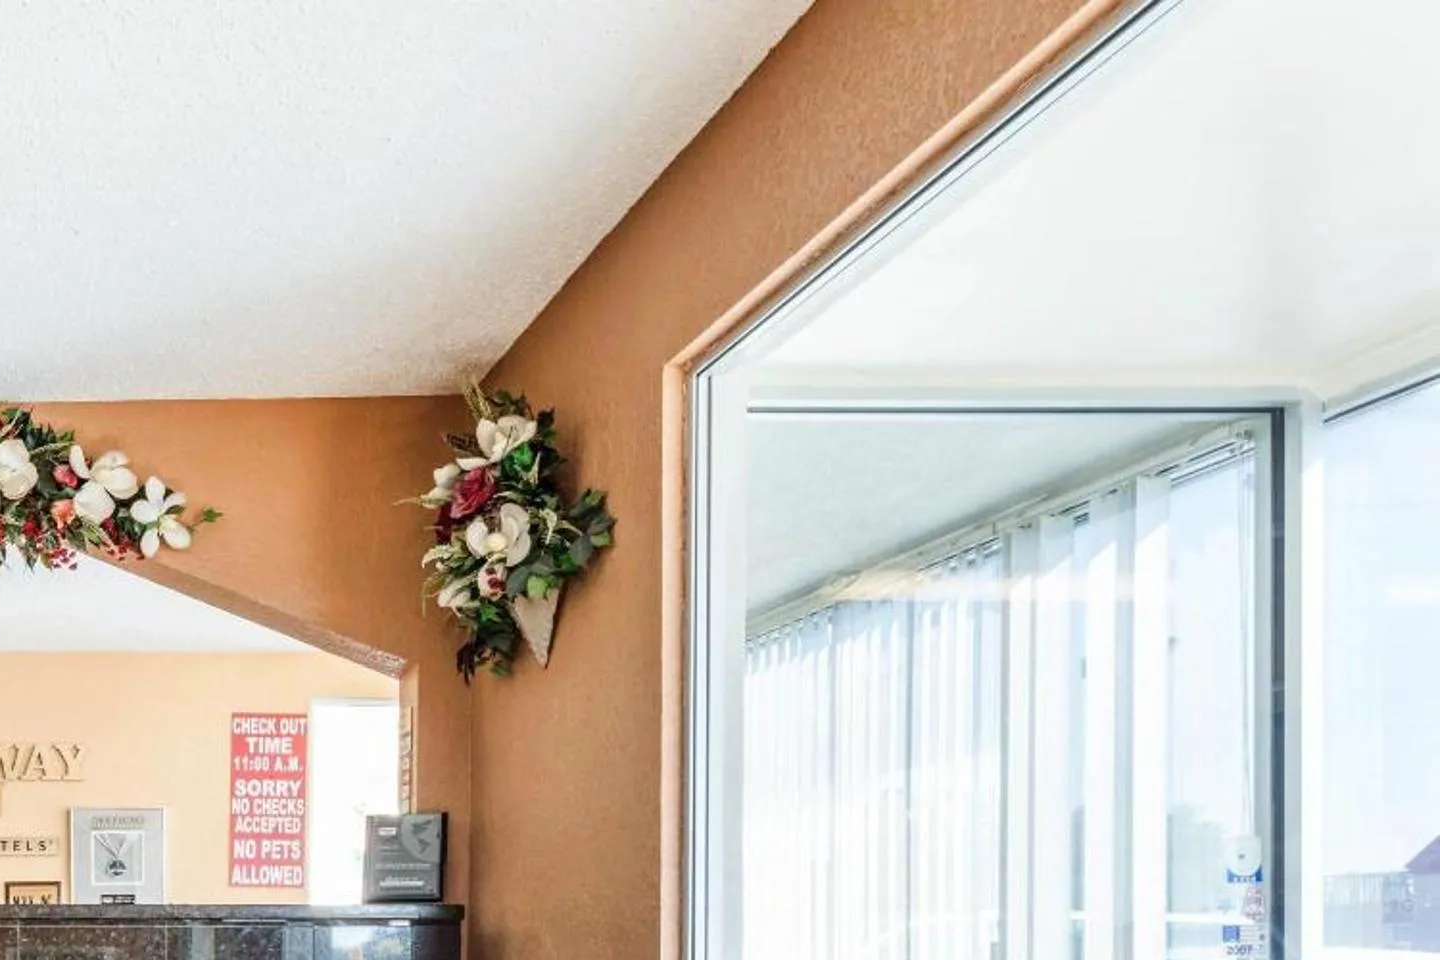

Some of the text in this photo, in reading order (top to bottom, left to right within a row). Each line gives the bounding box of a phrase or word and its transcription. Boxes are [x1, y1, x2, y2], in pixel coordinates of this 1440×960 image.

[233, 718, 307, 734] CHECK OUT
[246, 737, 293, 755] TIME
[234, 756, 304, 772] 11:00 A.M.
[234, 779, 303, 797] SORRY
[232, 799, 304, 816] NO CHECKS
[234, 817, 301, 834] ACCEPTED
[233, 840, 301, 860] NO PETS
[232, 865, 303, 885] ALLOWED
